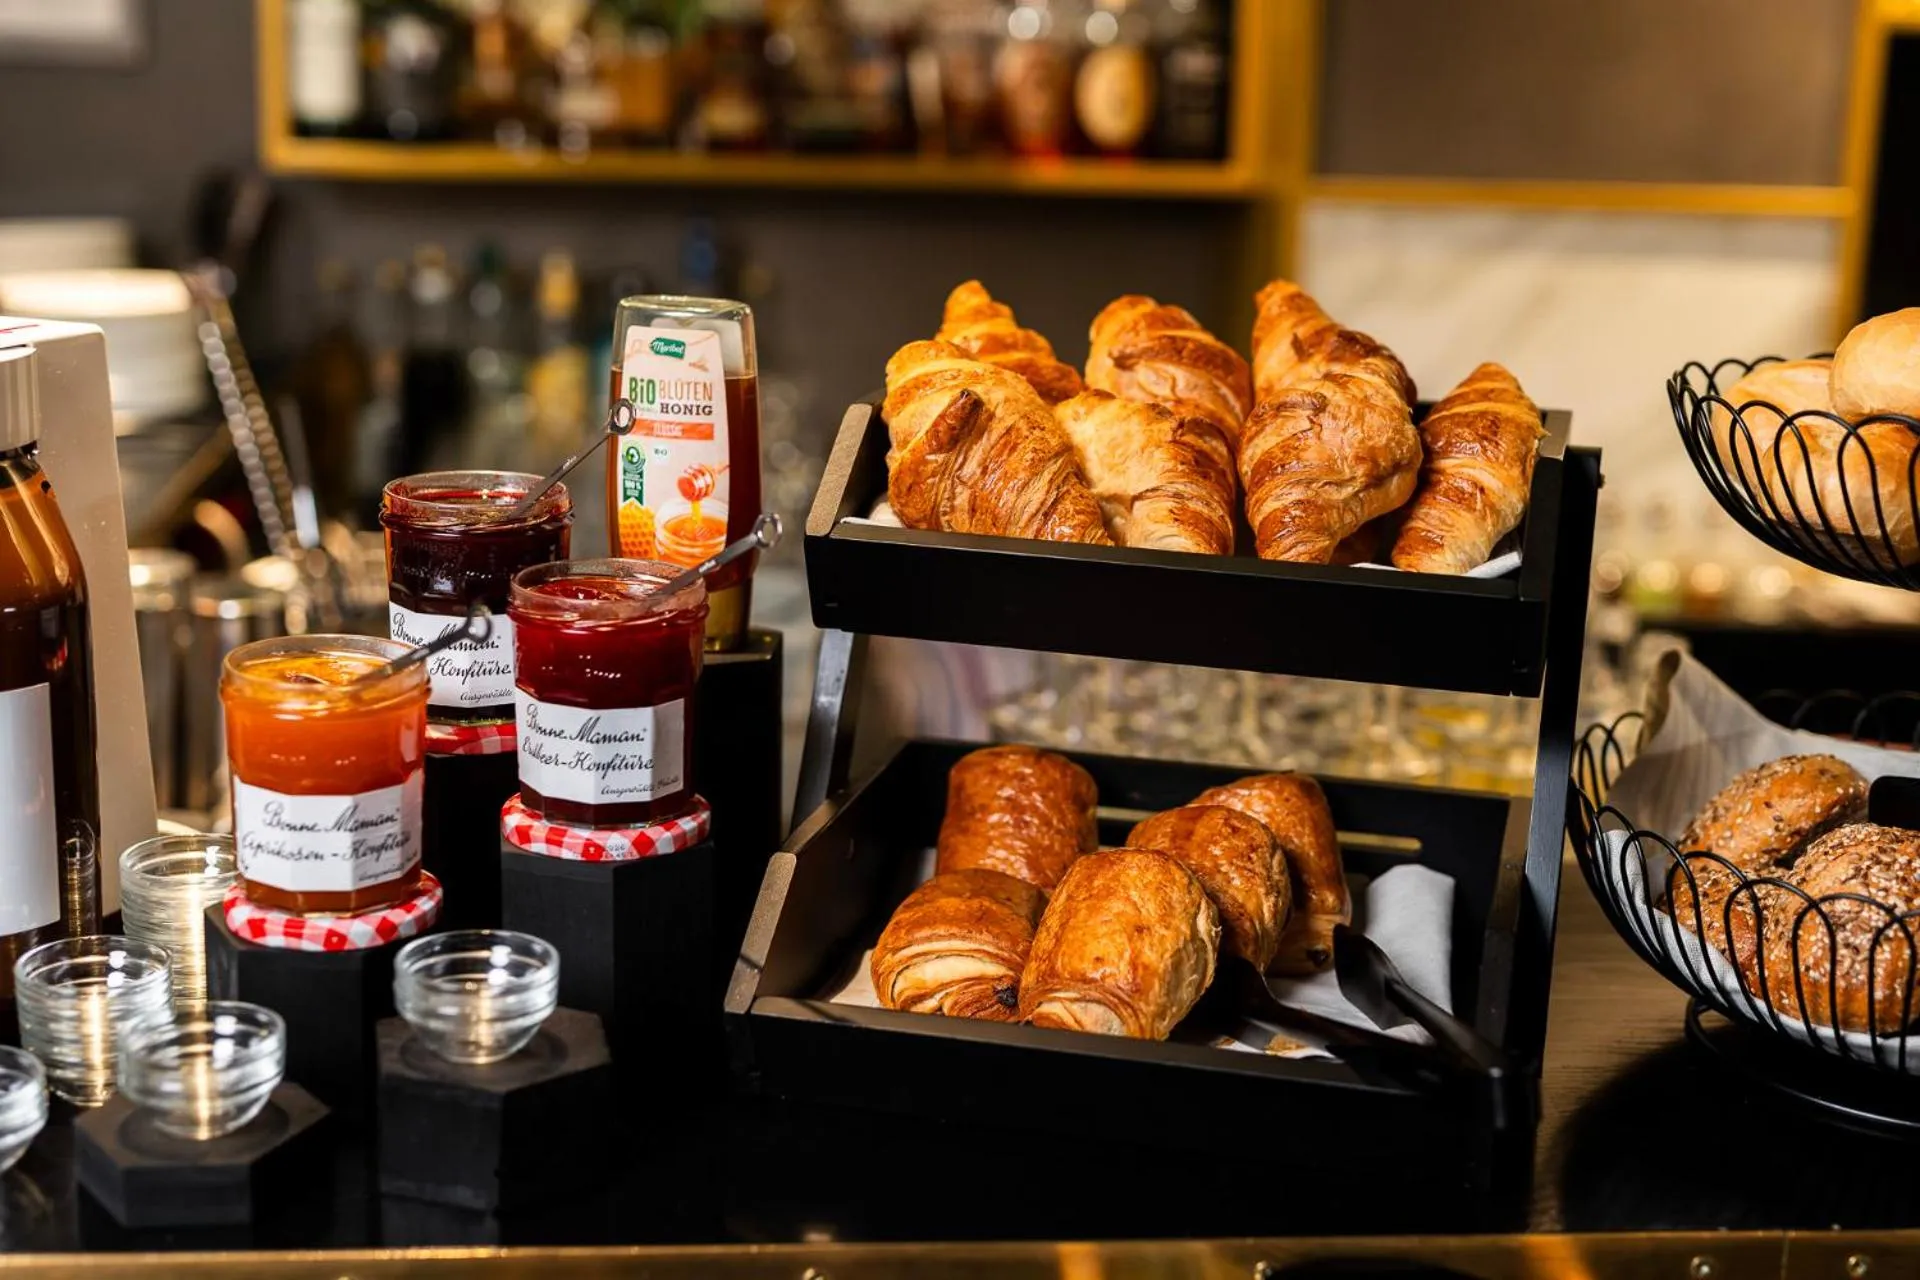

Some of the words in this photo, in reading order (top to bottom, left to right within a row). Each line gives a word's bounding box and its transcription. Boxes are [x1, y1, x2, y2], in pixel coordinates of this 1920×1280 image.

[659, 379, 713, 401] BLÜTEN
[660, 402, 713, 416] HONIG
[429, 657, 512, 685] Konfitüre
[525, 703, 568, 740] Bonne
[569, 716, 647, 745] Maman
[262, 800, 323, 833] Bonne
